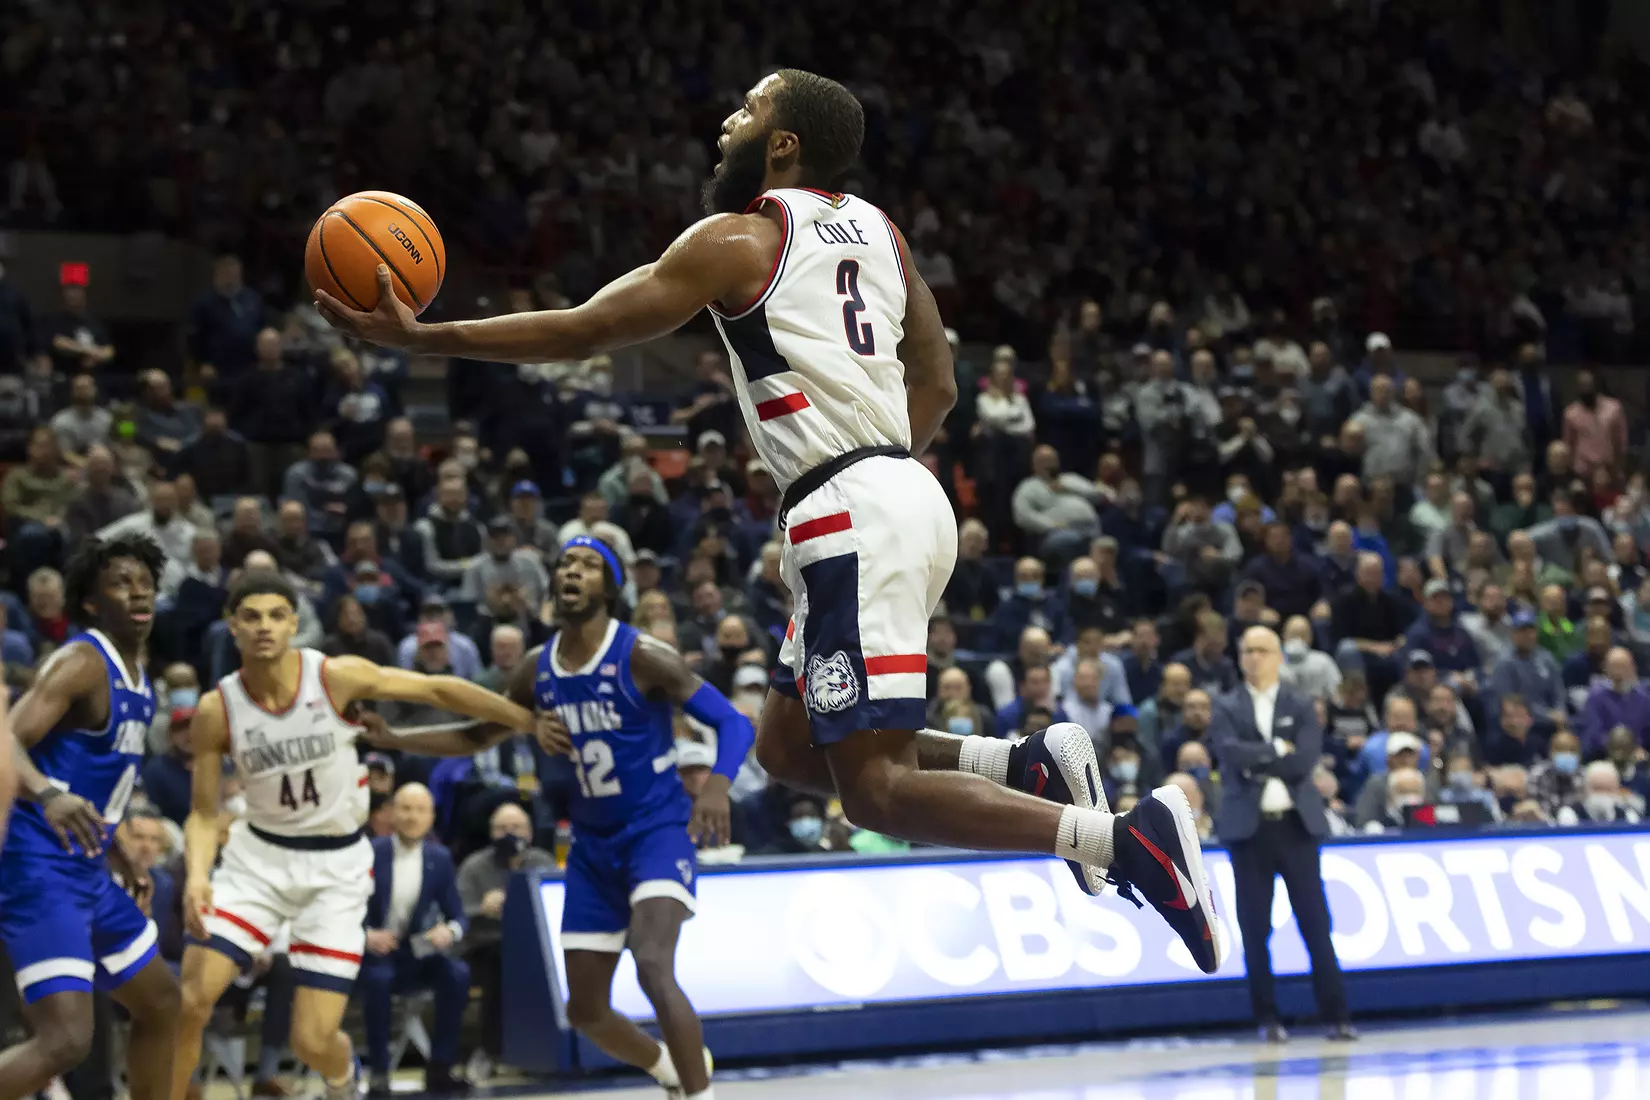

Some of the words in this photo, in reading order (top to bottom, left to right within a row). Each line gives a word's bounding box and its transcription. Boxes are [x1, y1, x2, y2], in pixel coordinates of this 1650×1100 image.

[388, 223, 423, 265] UCONN
[813, 219, 869, 246] COLE
[836, 259, 875, 356] 2
[280, 768, 320, 811] 44
[901, 861, 1142, 987] CBS
